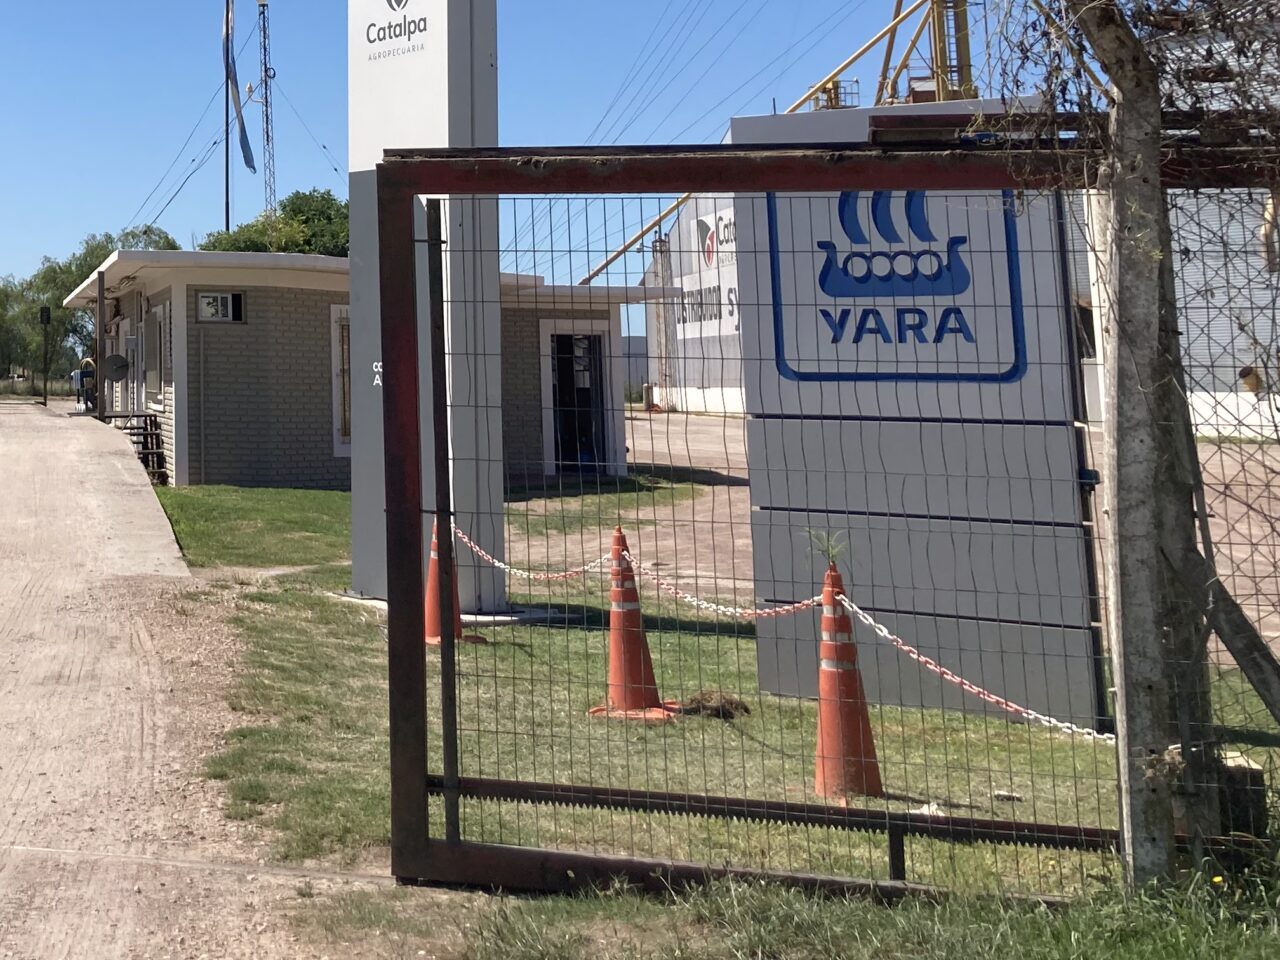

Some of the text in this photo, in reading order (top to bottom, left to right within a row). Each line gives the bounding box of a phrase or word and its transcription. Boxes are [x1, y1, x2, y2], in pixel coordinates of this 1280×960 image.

[366, 14, 427, 44] Catalpa
[367, 43, 425, 62] AGROPECUARIA
[819, 307, 977, 345] YARA
